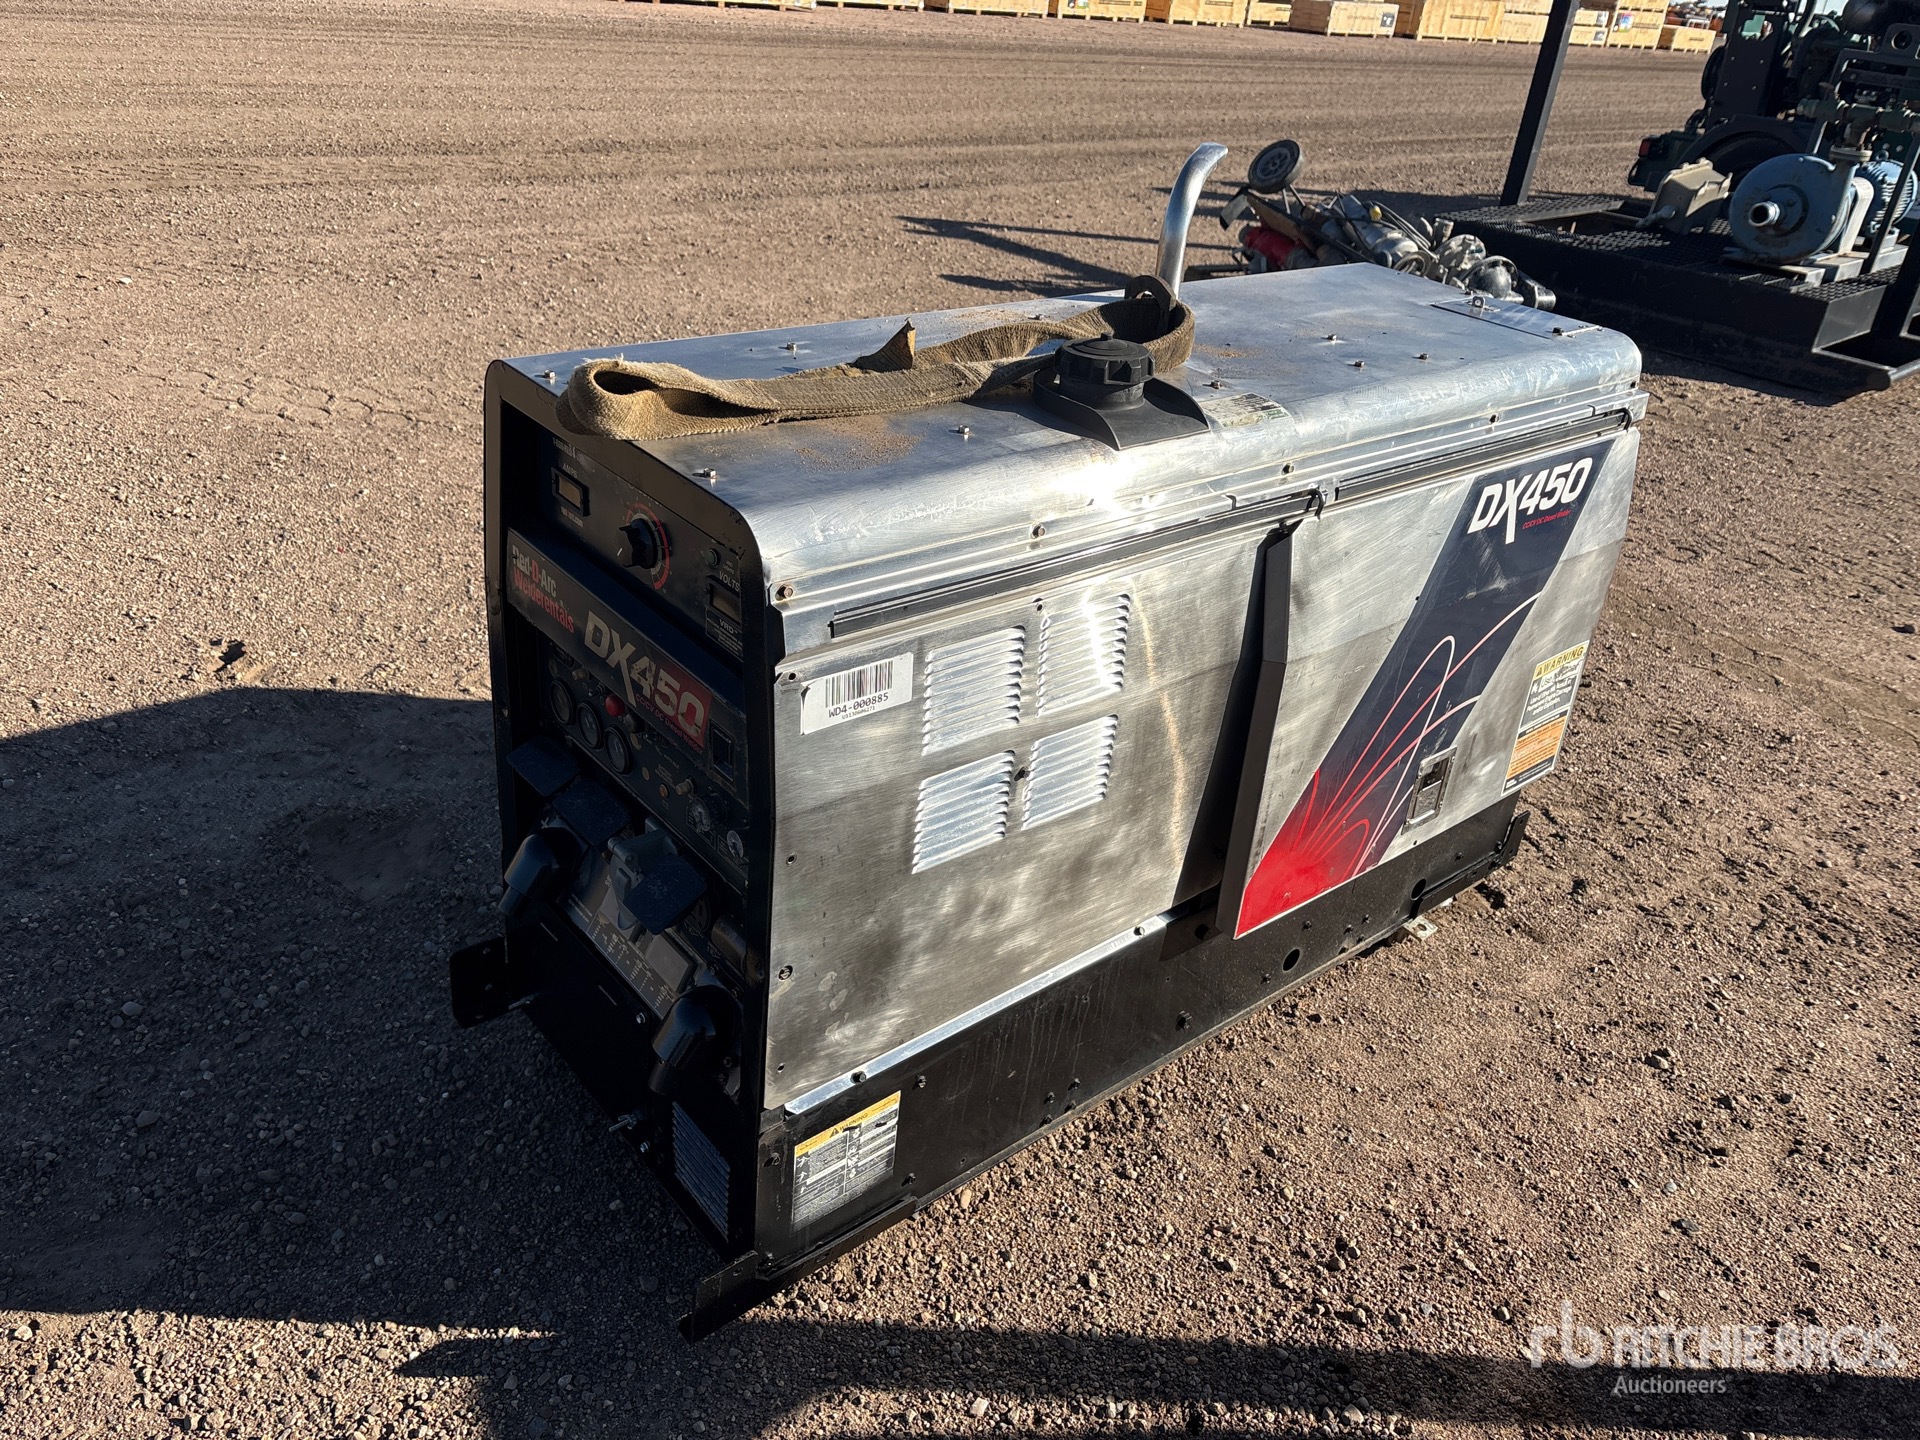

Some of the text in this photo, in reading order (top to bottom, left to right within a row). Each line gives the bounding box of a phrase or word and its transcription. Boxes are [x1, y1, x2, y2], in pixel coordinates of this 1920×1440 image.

[562, 463, 578, 479] AMPS
[1467, 457, 1593, 545] DX450
[512, 544, 557, 598] Red-D-Arc
[719, 570, 740, 592] VOLTS
[513, 565, 575, 634] Welderentals
[584, 610, 705, 738] DX450
[1544, 646, 1584, 673] WARNING
[828, 691, 889, 718] WD4-000885
